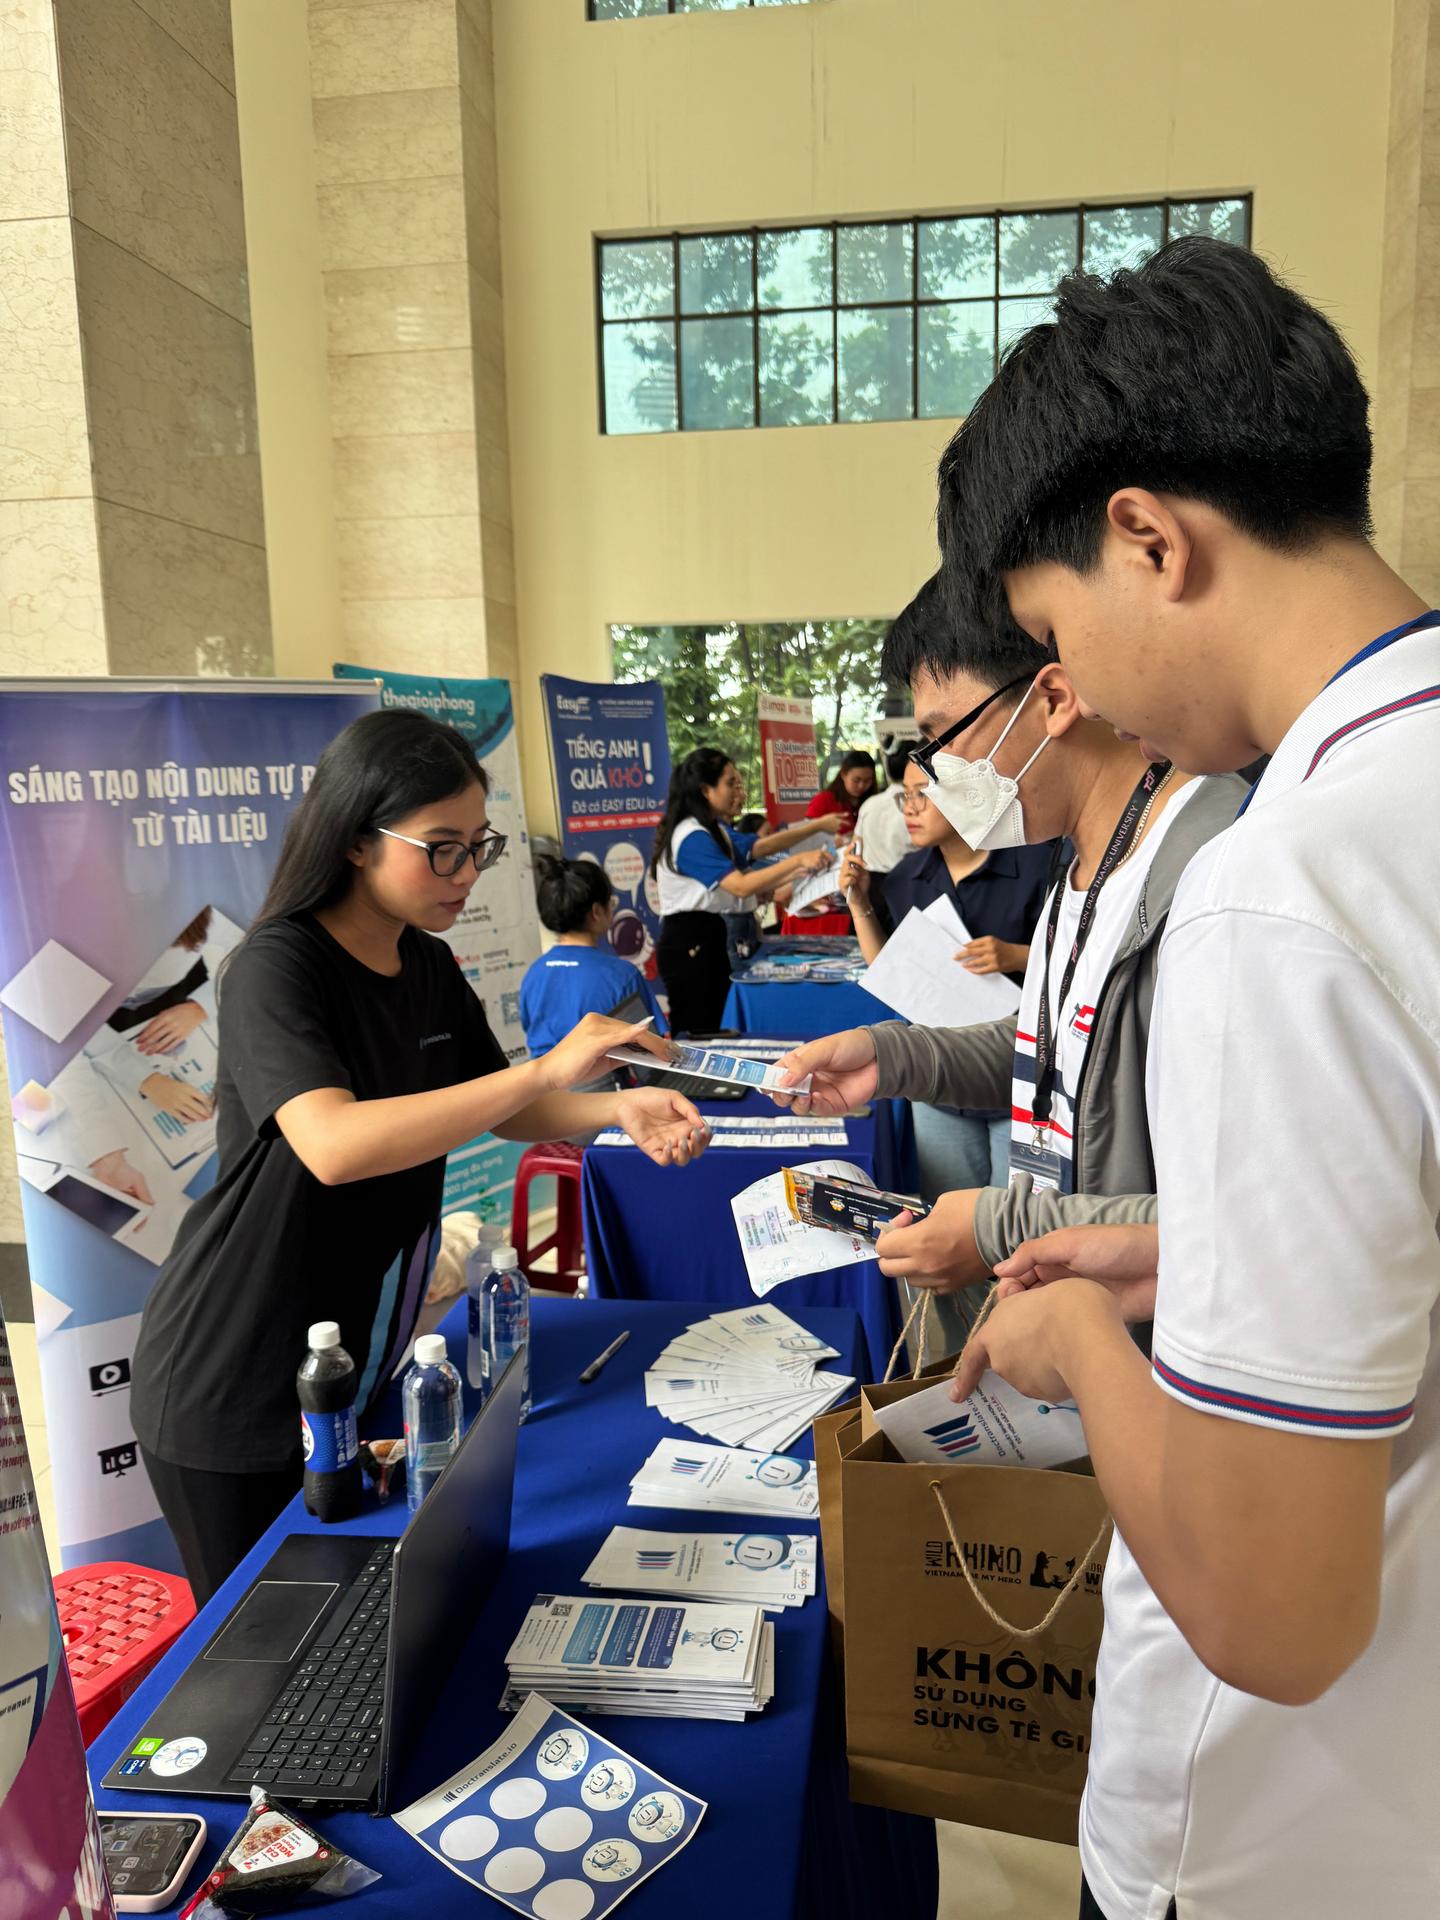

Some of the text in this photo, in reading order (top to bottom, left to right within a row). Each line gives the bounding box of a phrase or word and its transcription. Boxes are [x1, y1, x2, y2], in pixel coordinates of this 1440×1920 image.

[565, 733, 639, 759] TIẾNG ANH
[8, 764, 83, 804] SÁNG
[89, 769, 139, 806] TẠO
[146, 761, 189, 804] NỘI
[195, 766, 260, 797] DUNG
[265, 763, 296, 800] TỰ
[608, 762, 643, 789] KHÓ
[625, 797, 645, 811] EDU
[132, 806, 269, 848] TỪ TÀI LIỆU
[1080, 805, 1139, 930] TON DUC THANG UNIVERSITY
[966, 1397, 1006, 1457] Doctranslate.io
[925, 1541, 1023, 1575] WILD RHINO
[798, 1568, 810, 1590] Google
[981, 1573, 995, 1582] MY
[997, 1576, 1022, 1585] HERO
[916, 1647, 1096, 1700] KHÔN
[914, 1683, 1027, 1713] SỬ DỤNG
[913, 1707, 1091, 1754] SỪNG TÊ GI
[455, 1743, 518, 1794] Doctranslate.io
